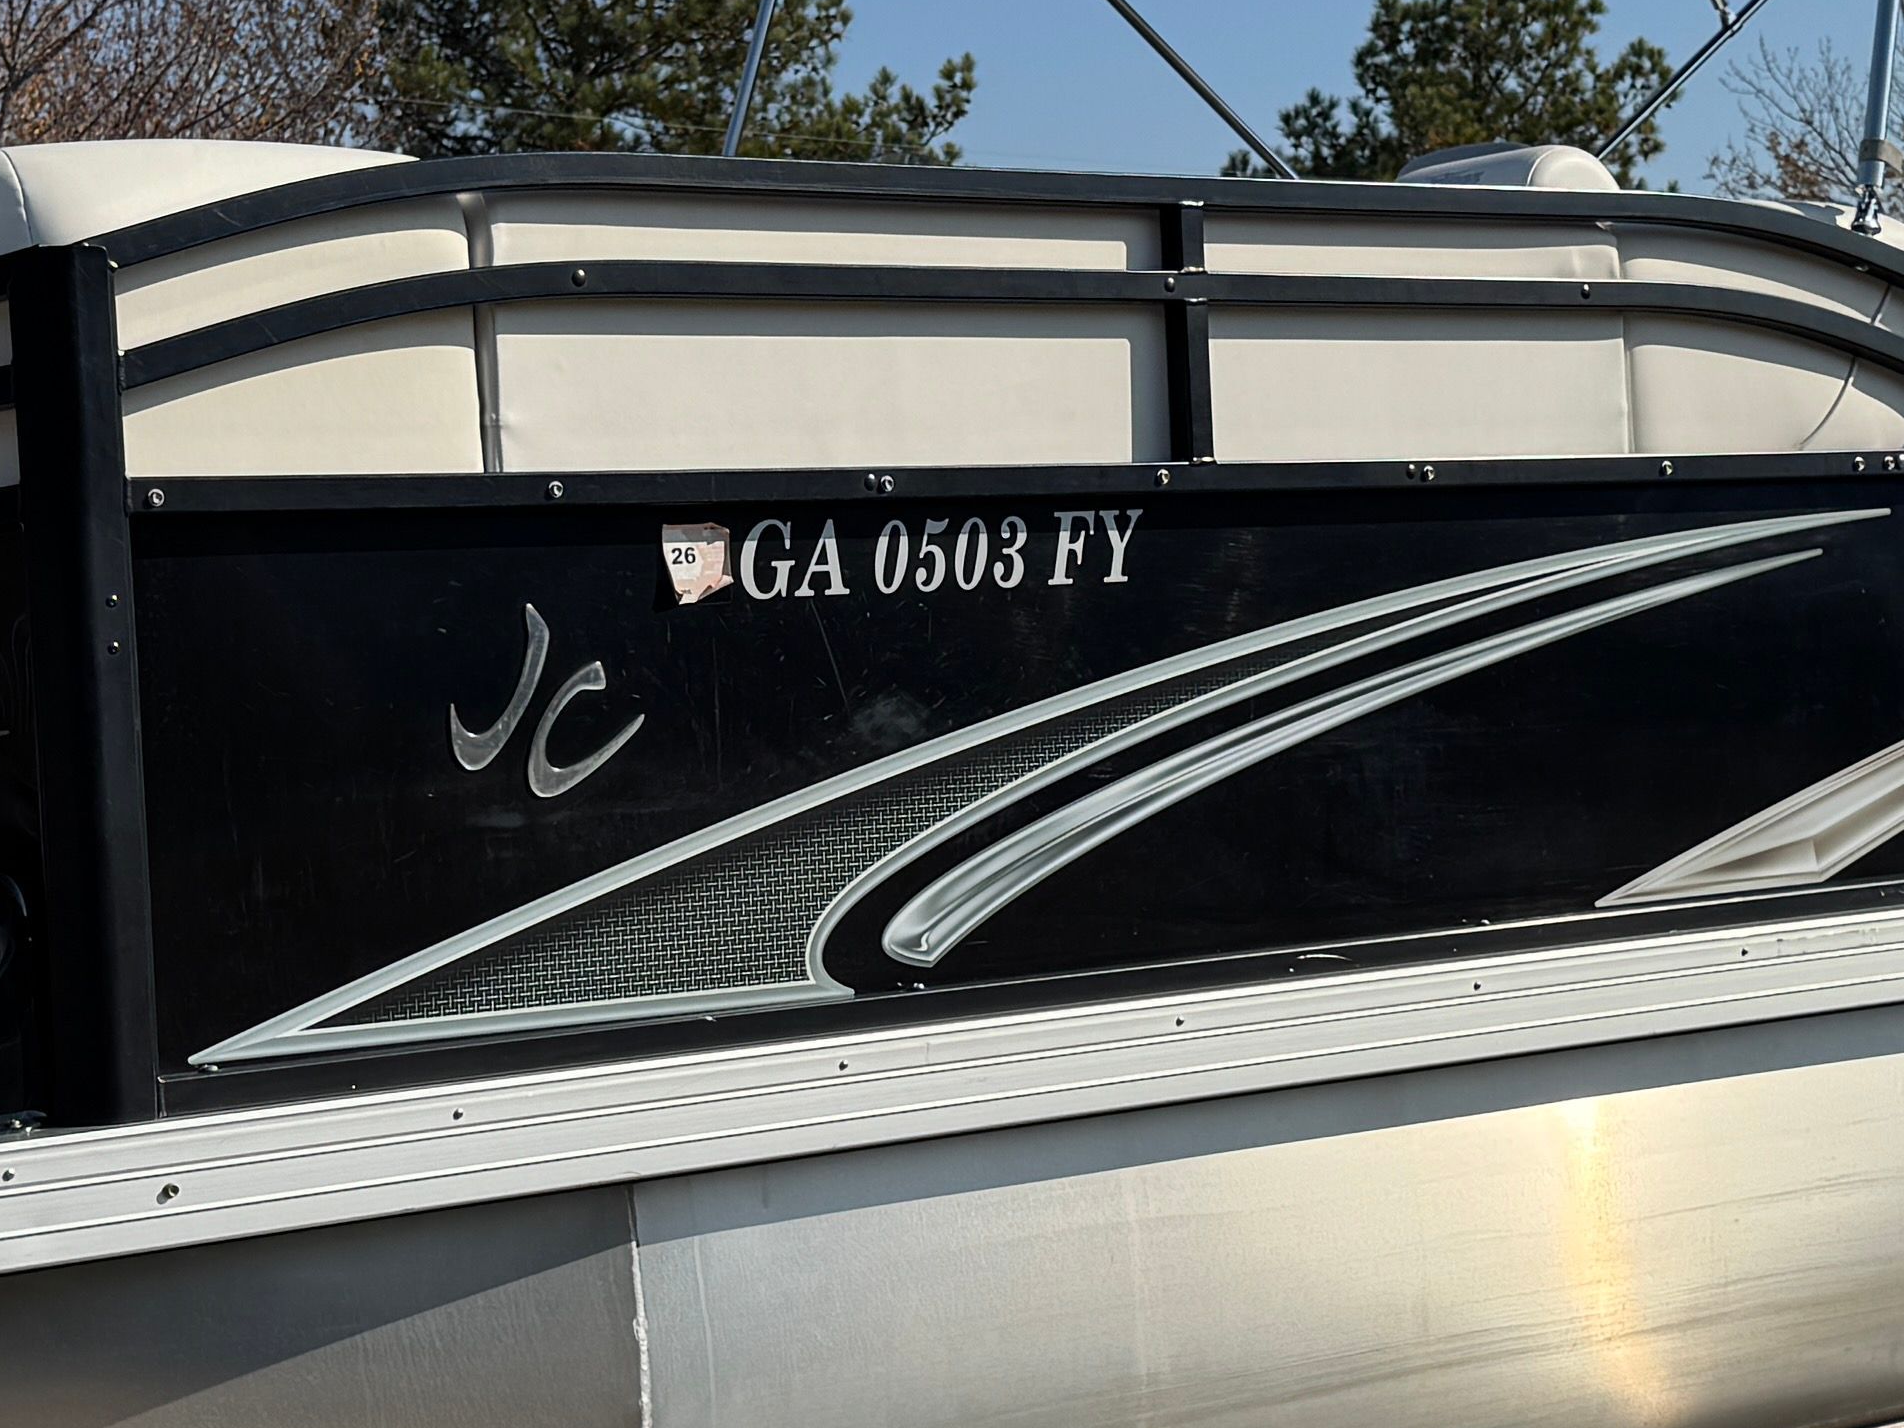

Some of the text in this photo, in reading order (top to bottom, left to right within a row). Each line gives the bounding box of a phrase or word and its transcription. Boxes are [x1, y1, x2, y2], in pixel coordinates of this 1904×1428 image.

[671, 547, 697, 565] 26
[740, 509, 1143, 599] GA 0503 FY
